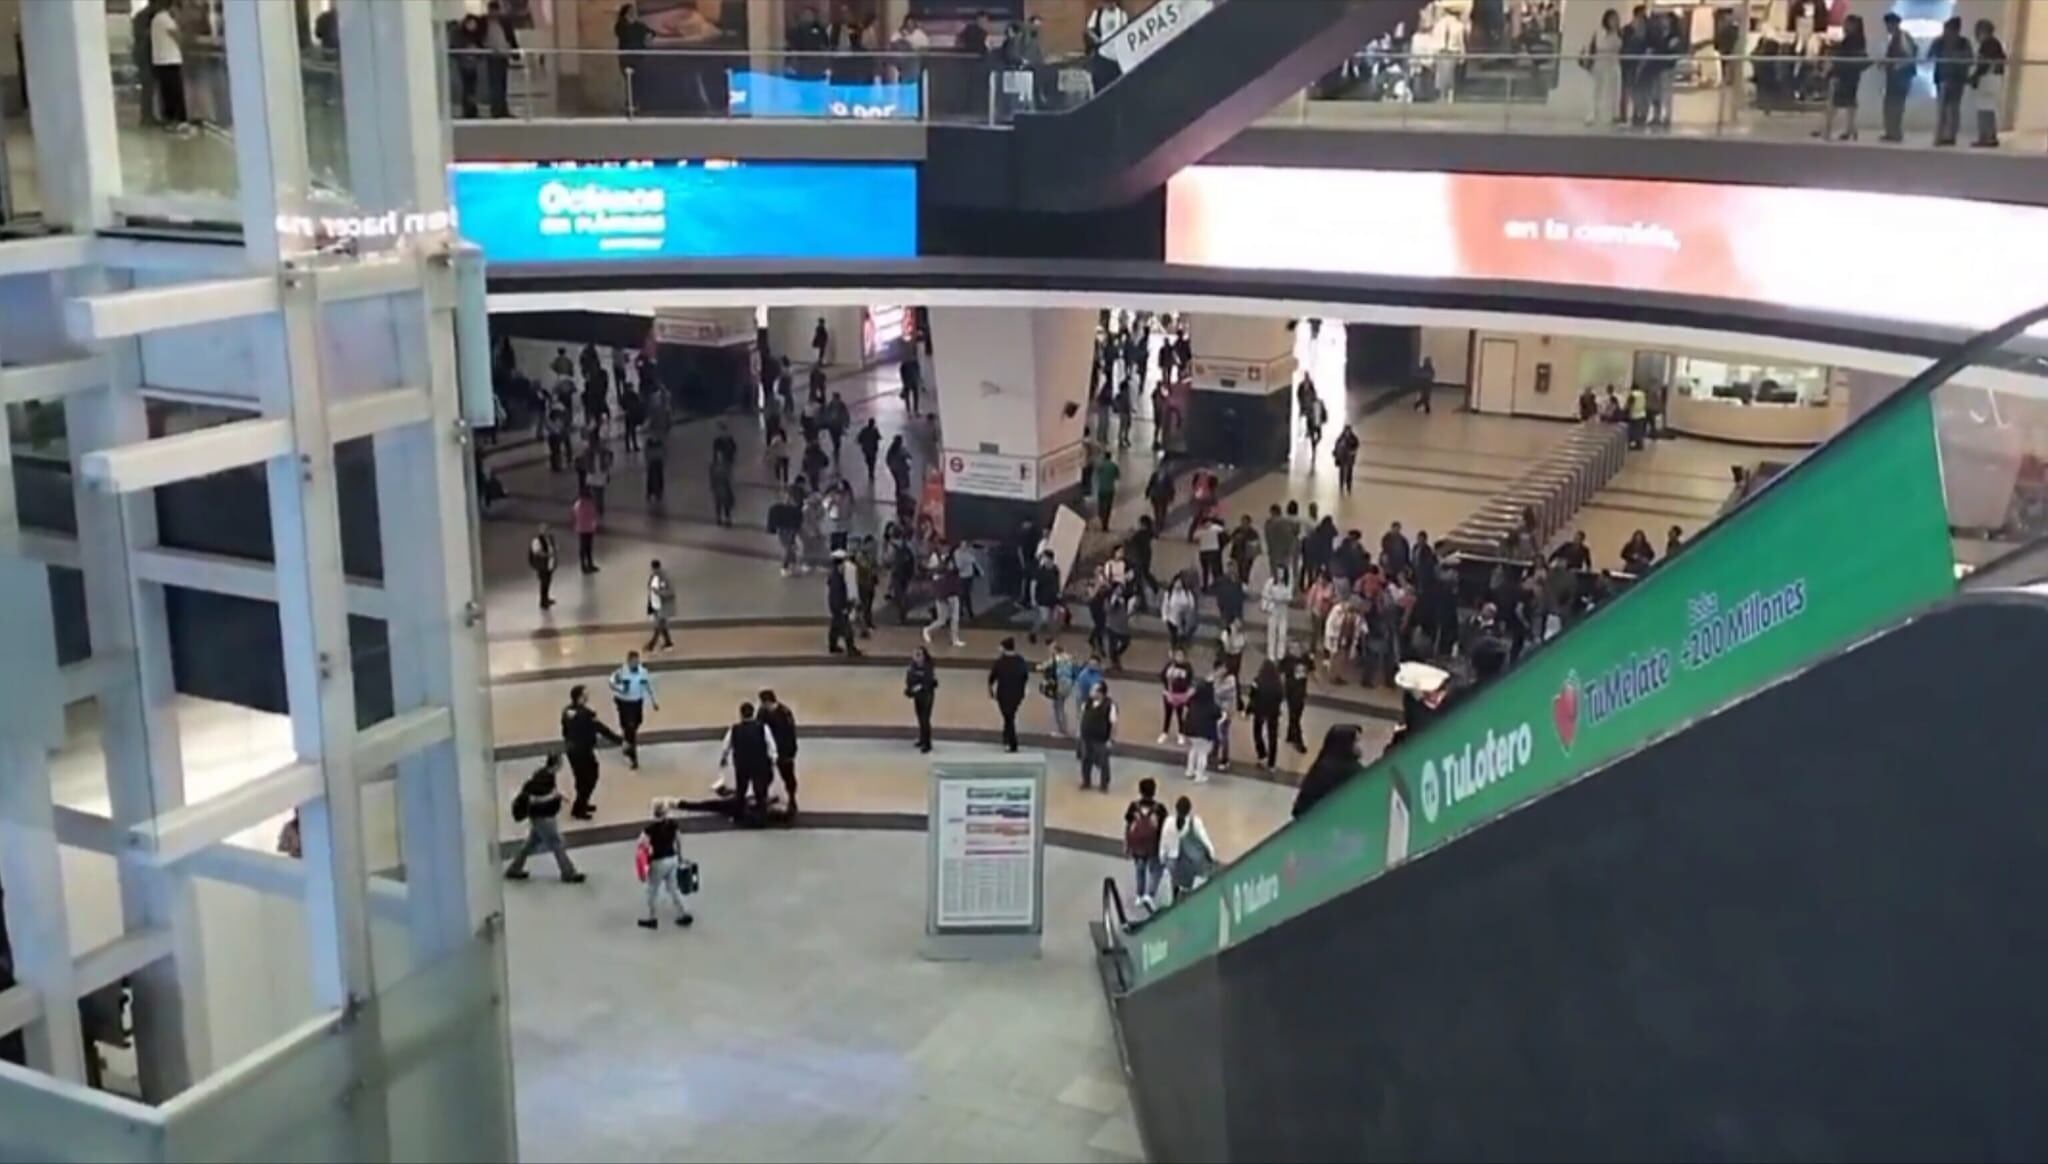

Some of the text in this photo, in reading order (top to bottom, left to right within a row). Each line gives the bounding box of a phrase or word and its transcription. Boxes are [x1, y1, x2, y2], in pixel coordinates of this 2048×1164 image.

[1127, 4, 1178, 52] PAPAS
[1727, 576, 1806, 652] Millones
[1584, 650, 1671, 728] TuMelate
[1442, 721, 1532, 807] TuLotero
